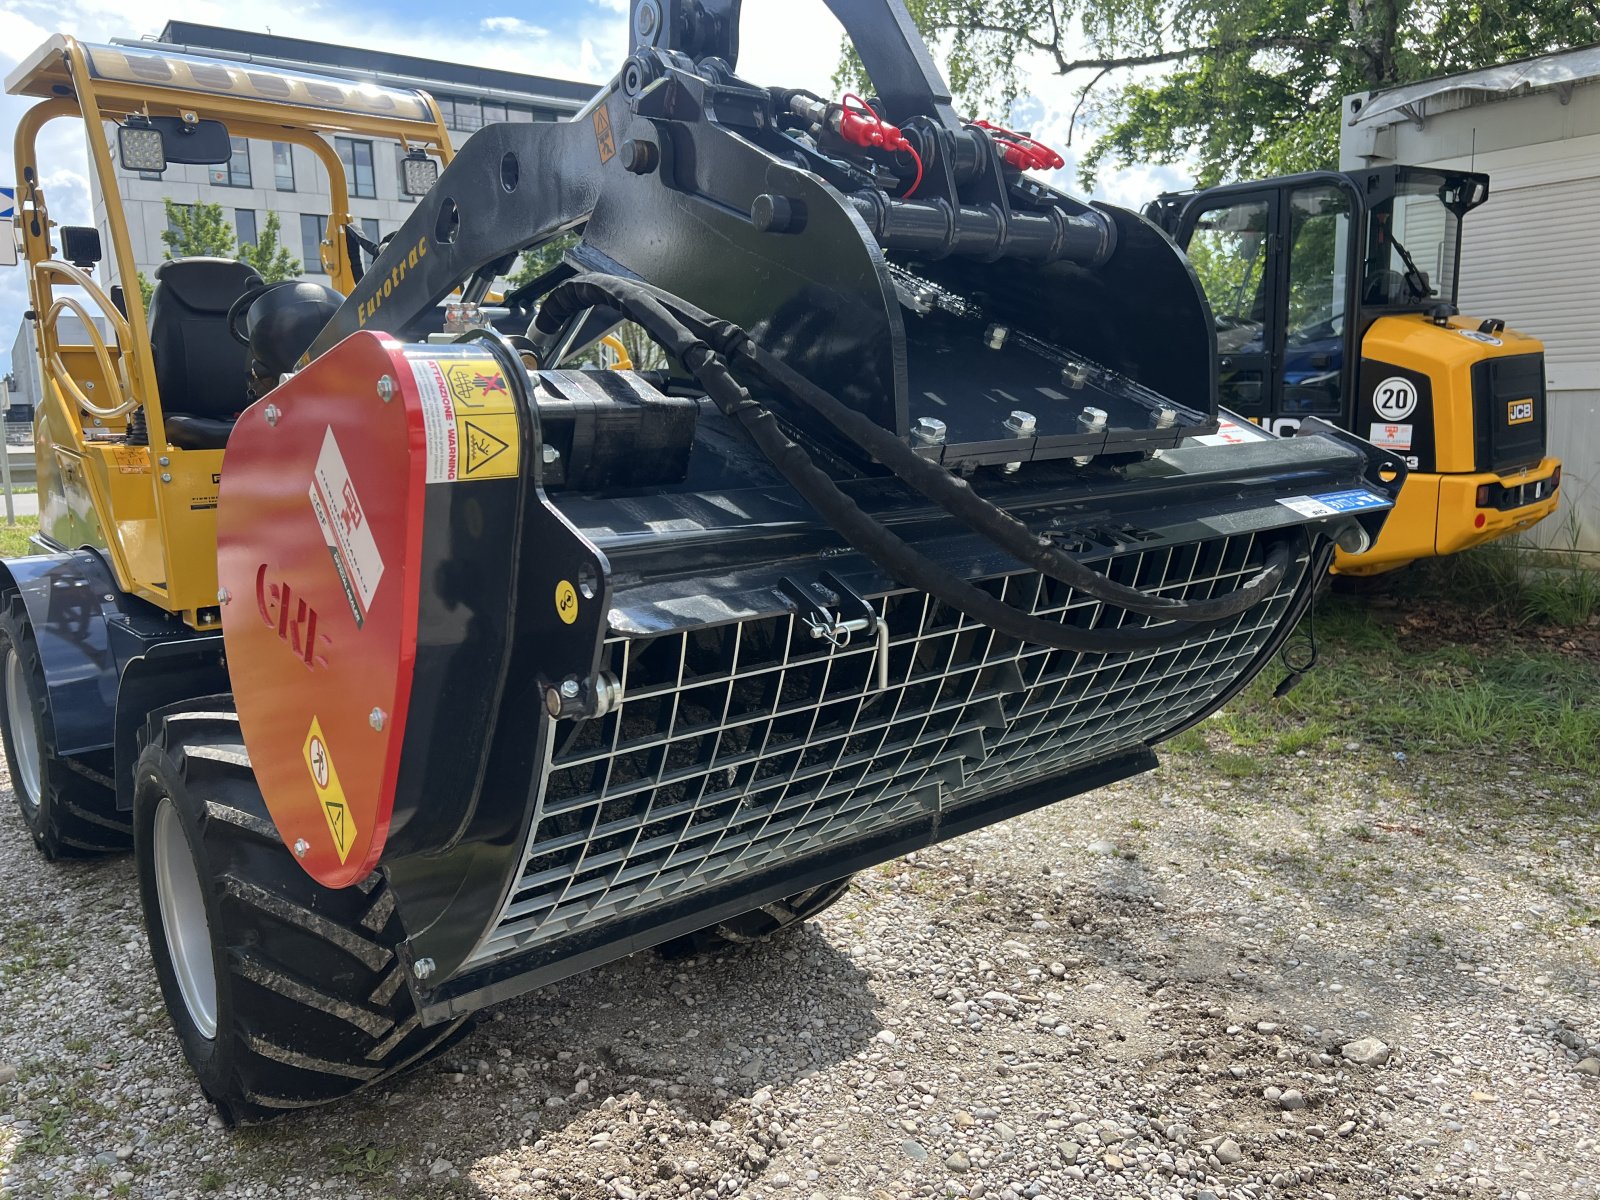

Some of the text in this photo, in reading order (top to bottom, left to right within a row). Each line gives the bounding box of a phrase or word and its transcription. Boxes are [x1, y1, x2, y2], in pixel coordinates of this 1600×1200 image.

[357, 235, 427, 328] Eurotrac
[427, 360, 456, 480] ATTENZIONE WARNING
[1381, 388, 1409, 409] 20
[1510, 403, 1532, 420] JCB
[344, 484, 361, 524] FH
[333, 553, 348, 589] OFFICIAL
[346, 588, 361, 622] DEALER
